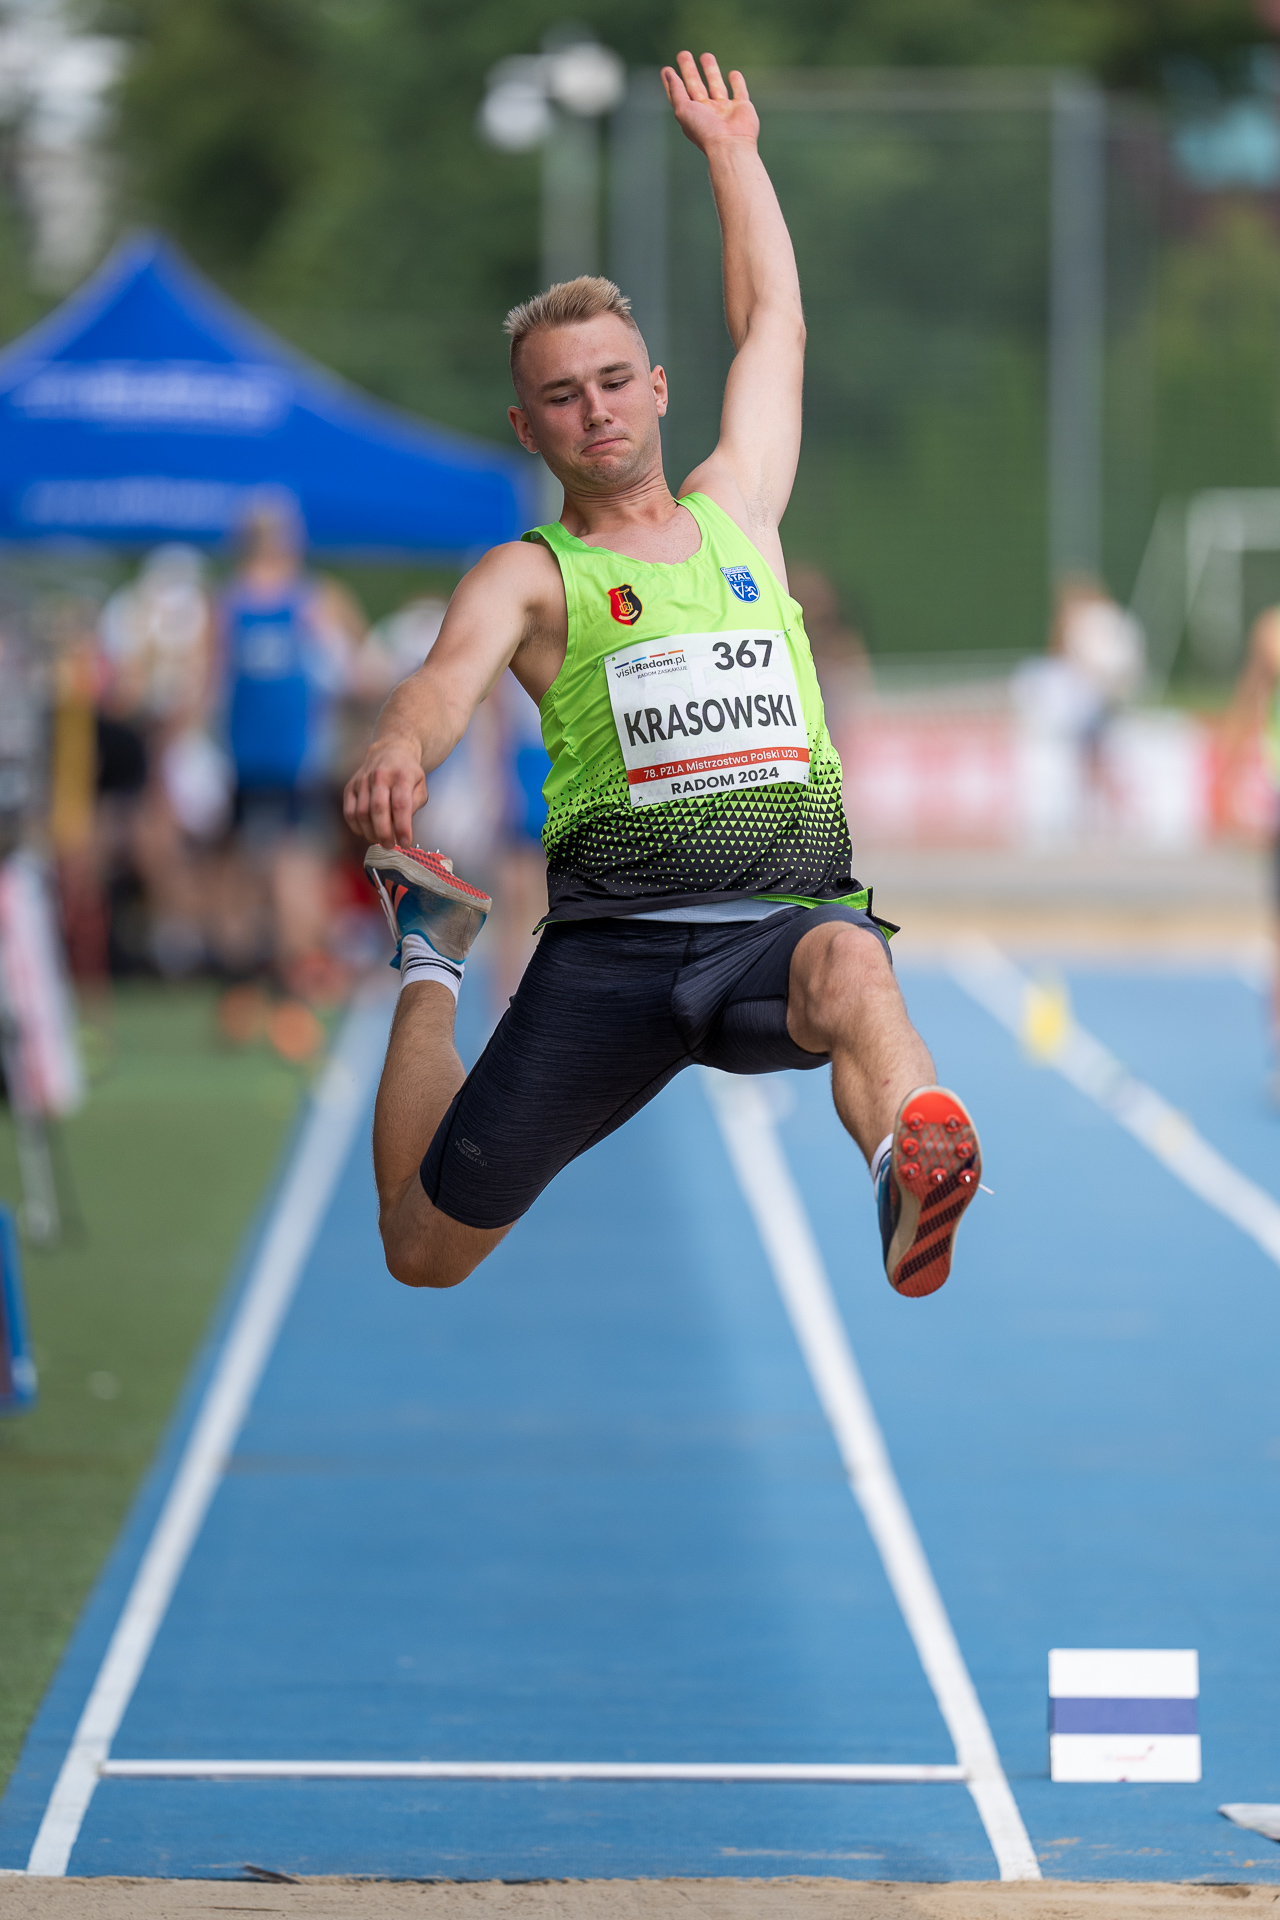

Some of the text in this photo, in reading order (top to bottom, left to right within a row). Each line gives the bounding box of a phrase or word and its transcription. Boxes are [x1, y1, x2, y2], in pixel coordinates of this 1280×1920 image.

[616, 654, 686, 678] visitRadom.pl
[712, 639, 773, 671] 367
[637, 665, 688, 679] RADOM ZASKAKUJE
[623, 694, 797, 747] KRASOWSKI
[643, 749, 799, 780] 78. PZLA Mistrzostwa Polski U20
[671, 766, 780, 795] RADOM 2024
